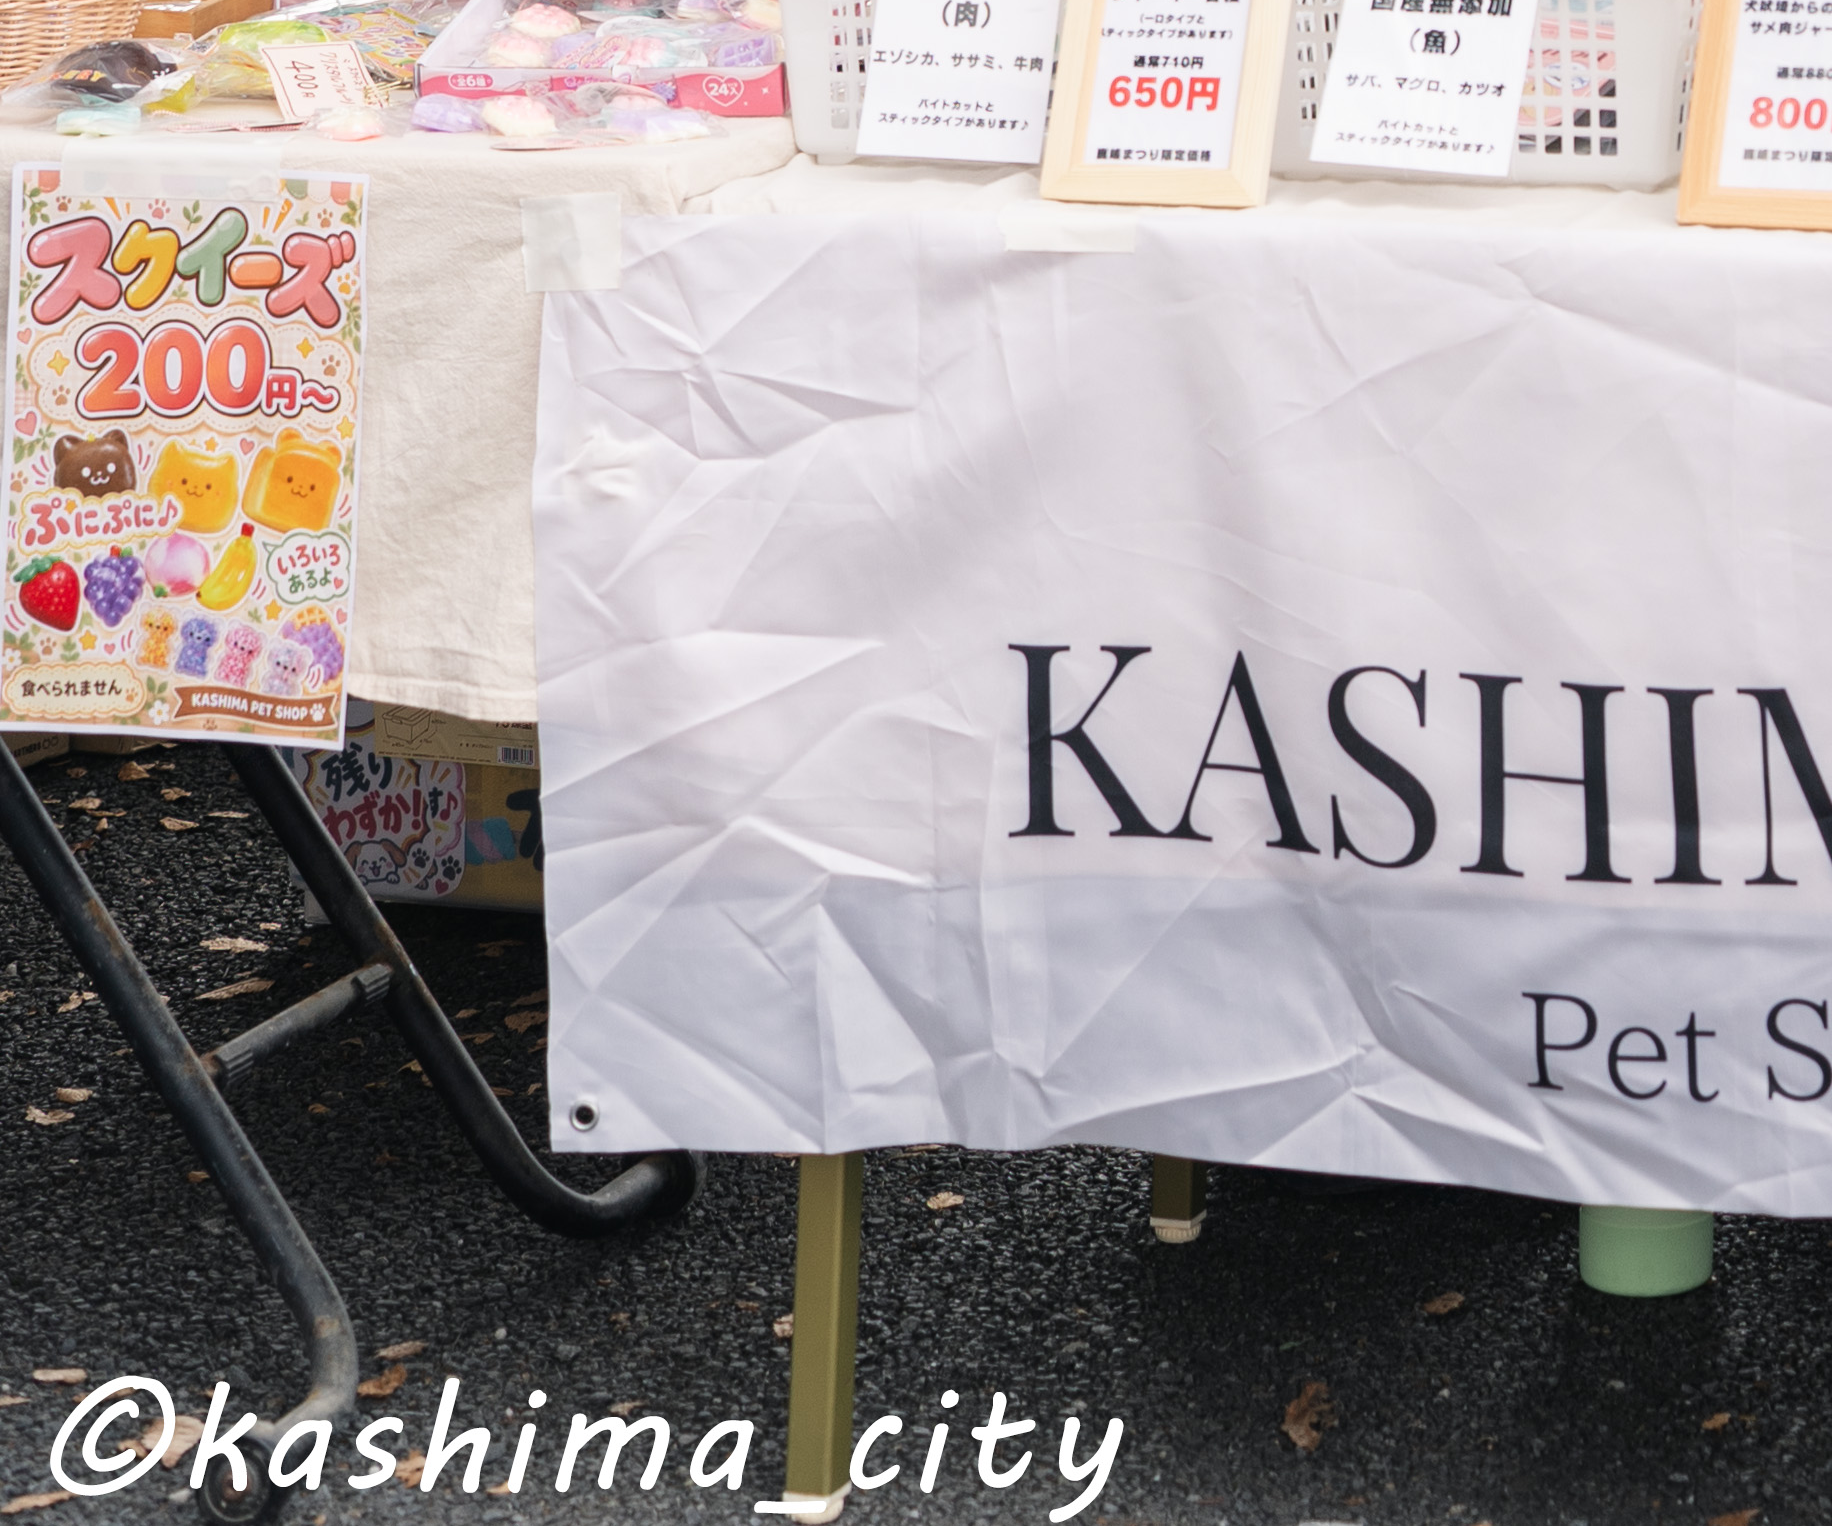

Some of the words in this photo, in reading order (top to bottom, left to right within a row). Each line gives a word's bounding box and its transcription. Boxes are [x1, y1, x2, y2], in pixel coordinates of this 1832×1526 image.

[918, 99, 994, 113] バイトカットと
[1108, 75, 1221, 112] 650円
[27, 207, 356, 329] スクイーズ
[276, 542, 342, 574] いろいろ
[288, 567, 333, 594] あるよ
[20, 677, 123, 700] 食べられません
[191, 693, 248, 714] KASHIMA
[250, 699, 274, 716] PET
[275, 702, 309, 721] SHOP
[320, 742, 393, 803] 残り
[1522, 991, 1716, 1106] Pet
